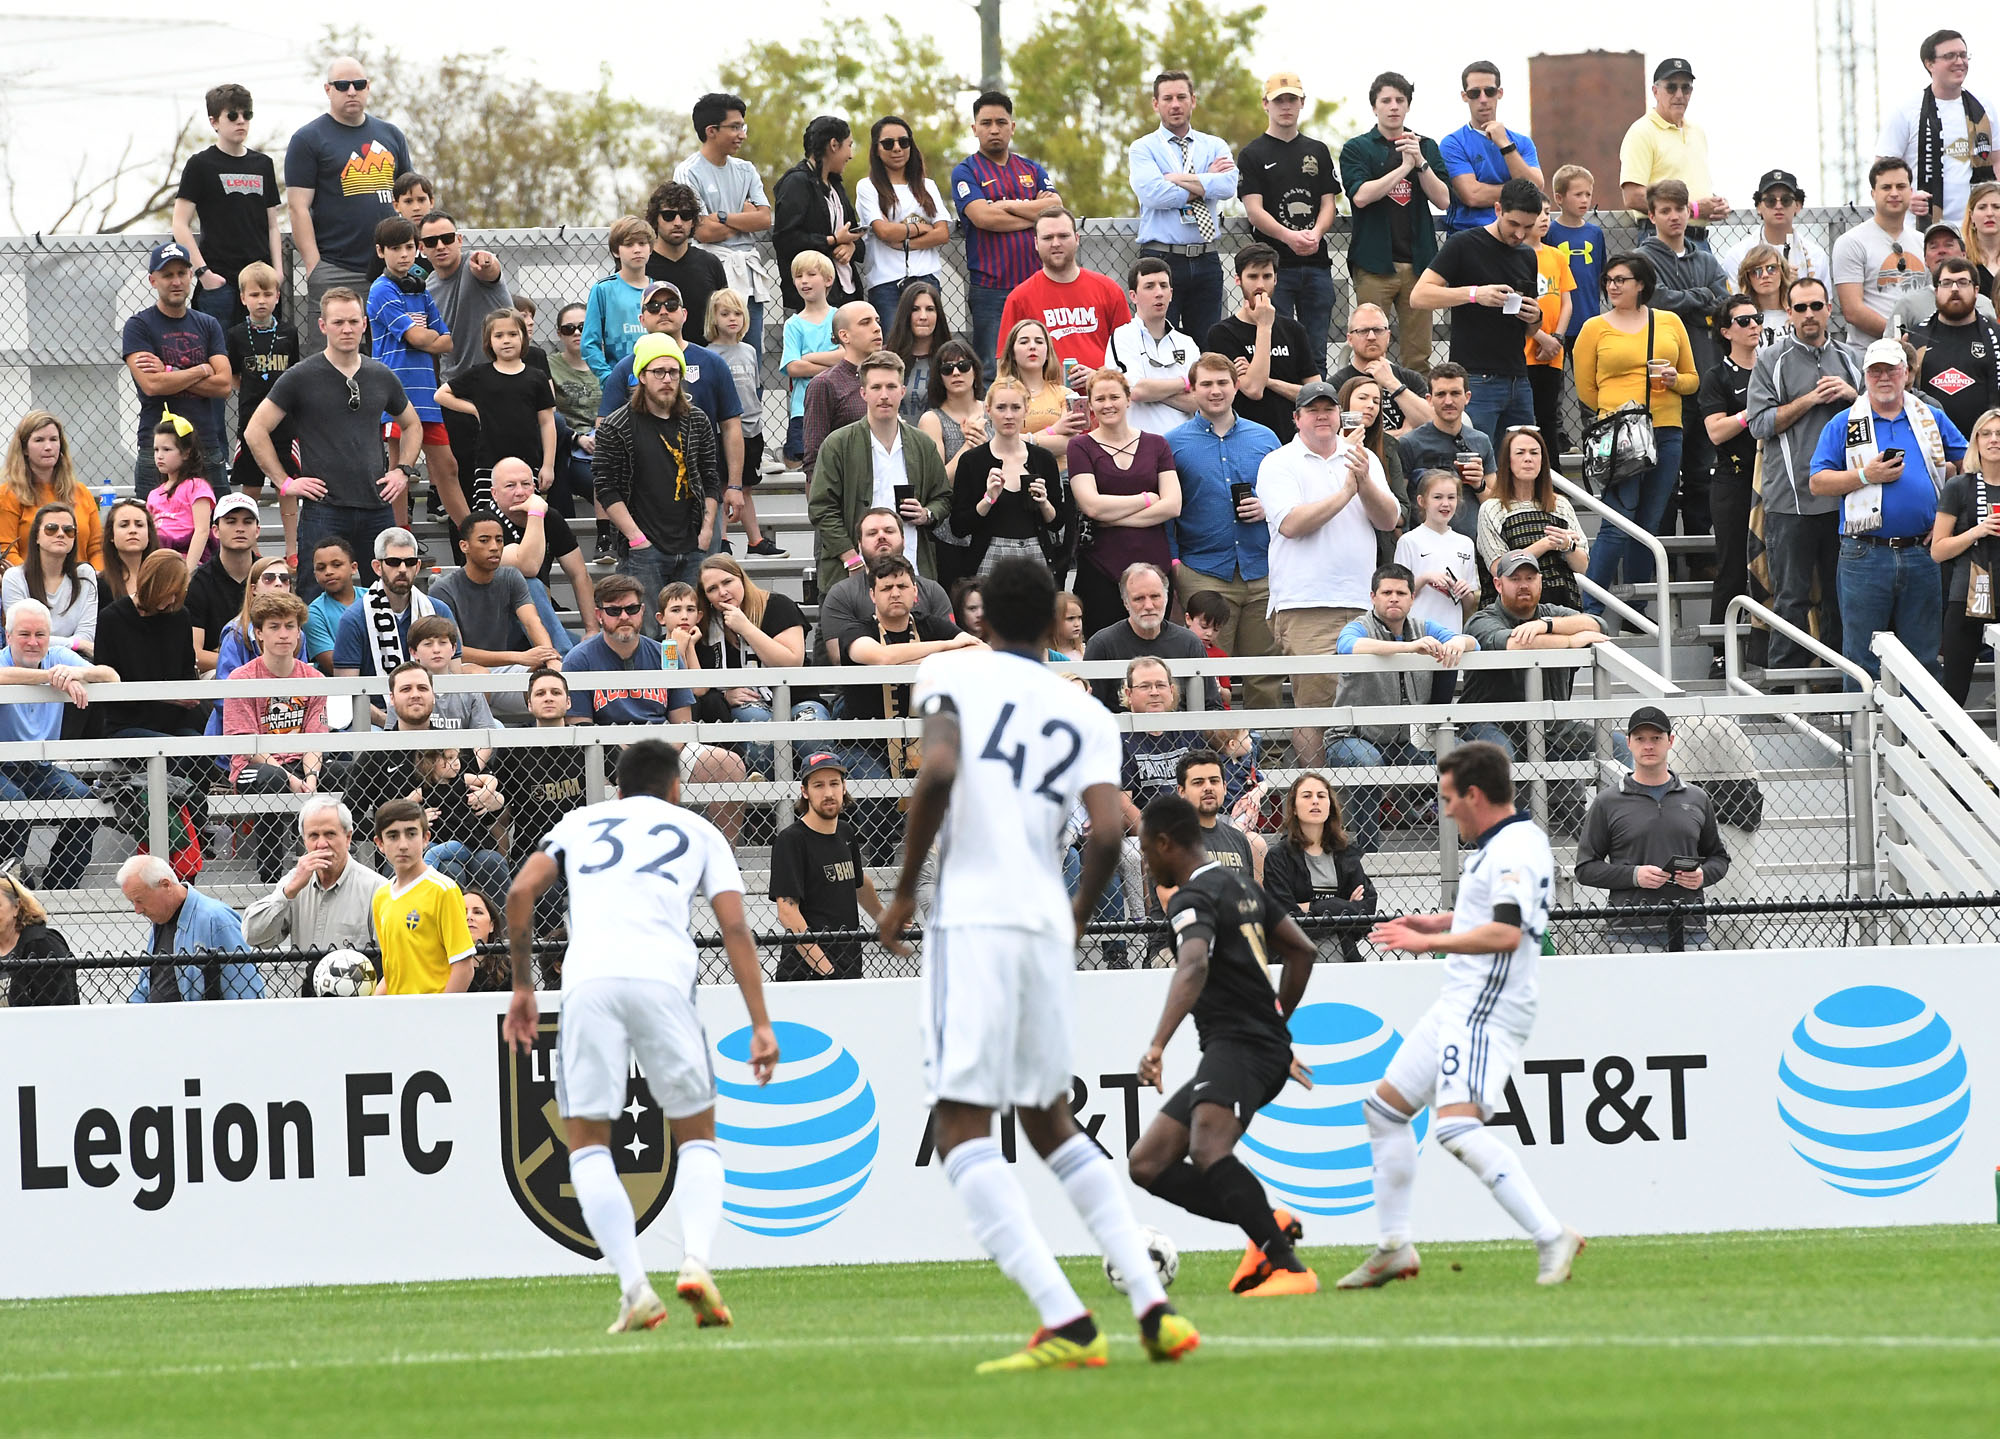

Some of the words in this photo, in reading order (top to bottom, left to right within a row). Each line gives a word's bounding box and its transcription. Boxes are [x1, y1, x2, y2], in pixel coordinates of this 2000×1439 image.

[1042, 306, 1097, 327] BUMM
[256, 354, 289, 371] BHM
[980, 703, 1081, 804] 42
[1136, 756, 1179, 780] PANTH
[544, 777, 581, 801] BHM
[578, 818, 690, 885] 32
[1441, 1045, 1460, 1076] 8
[1483, 1055, 1707, 1146] AT&T
[18, 1078, 315, 1212] Legion
[345, 1070, 454, 1177] FC
